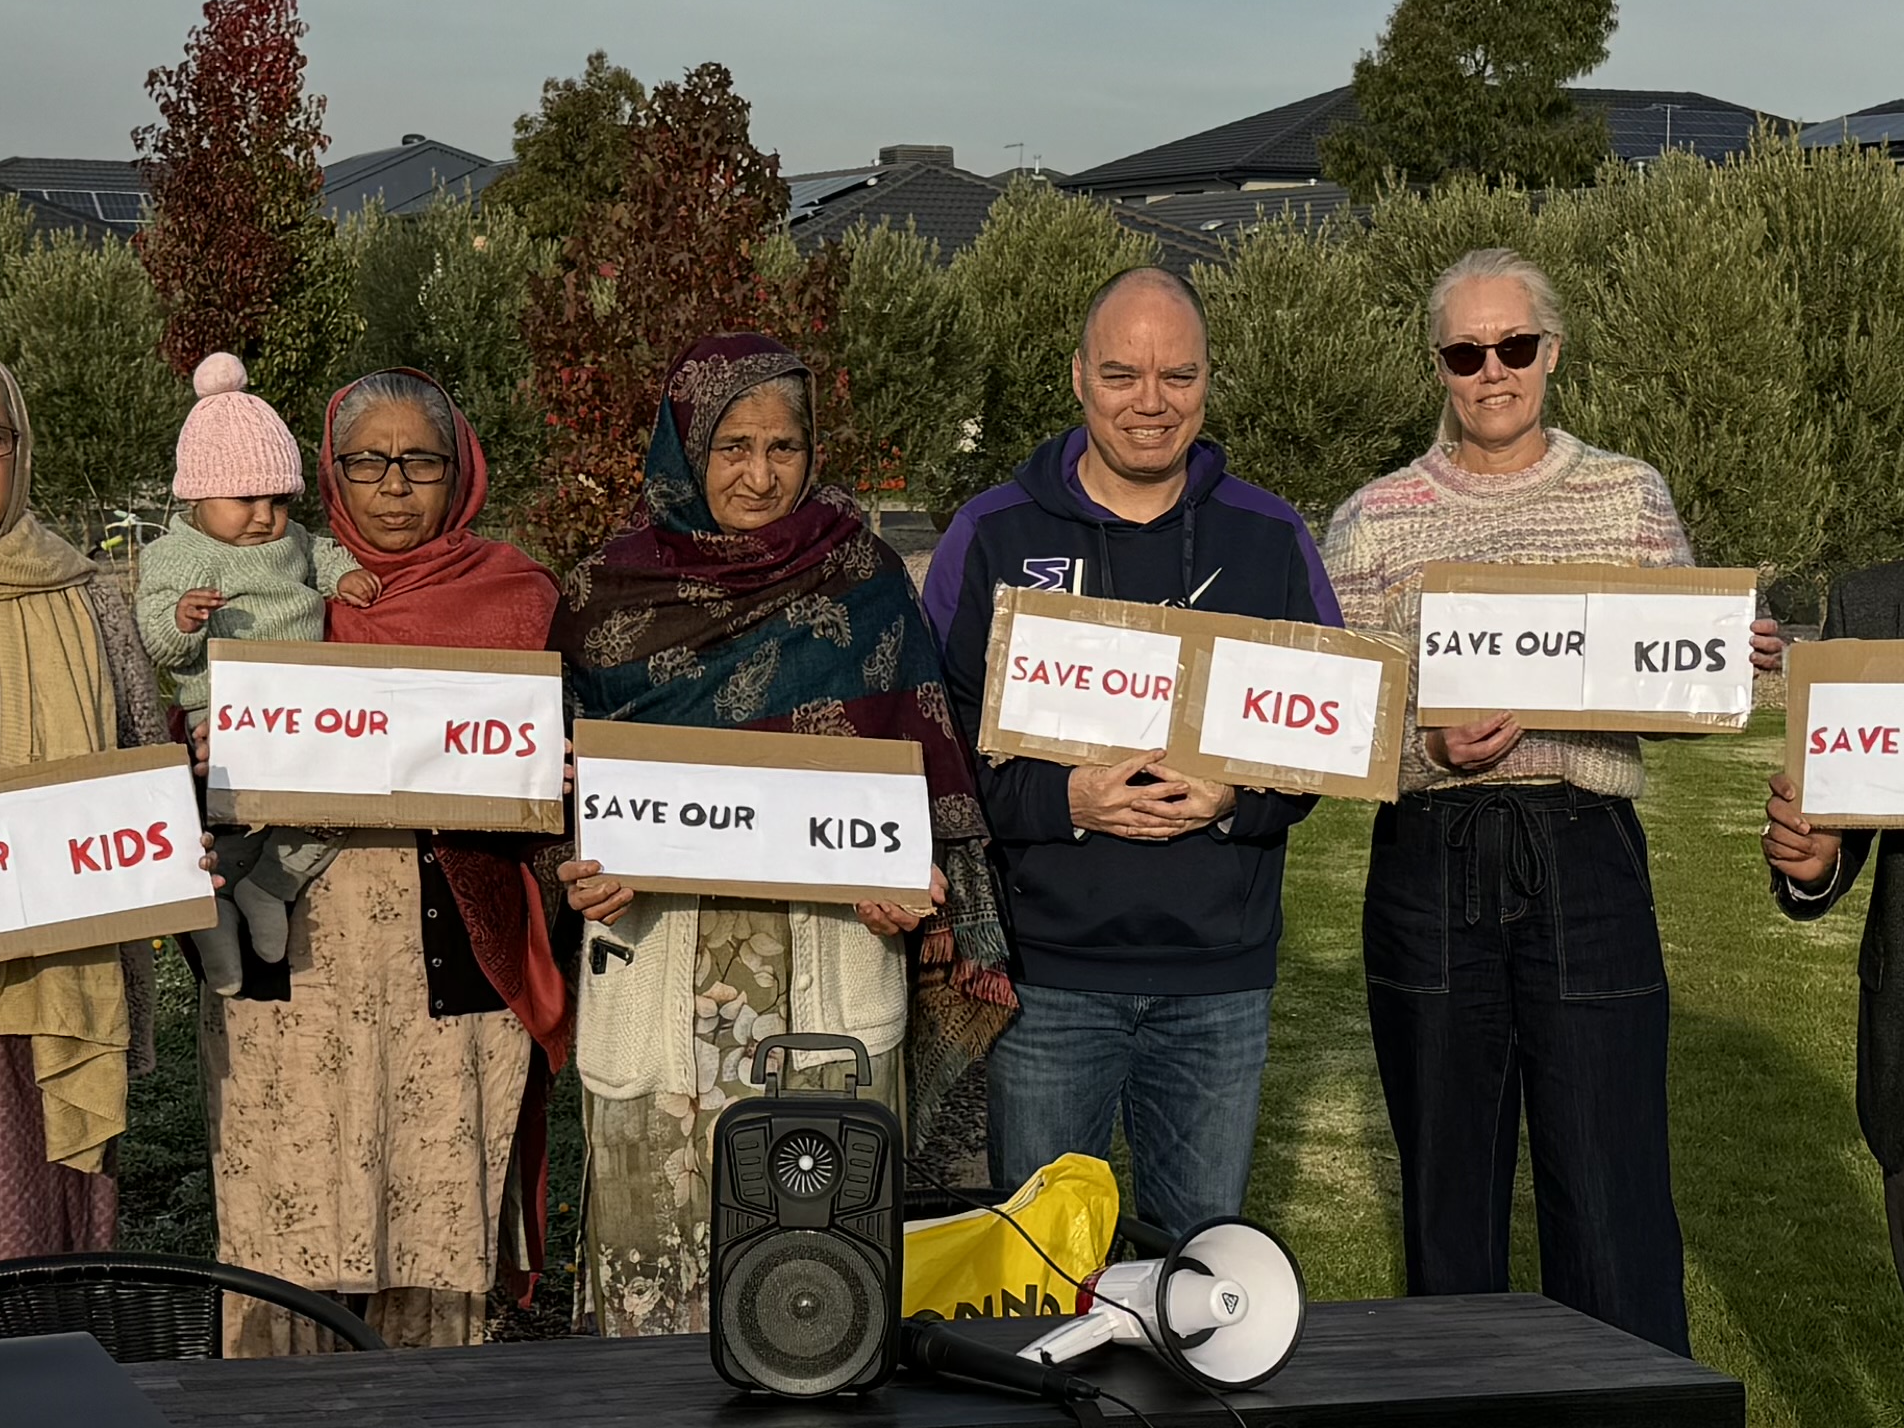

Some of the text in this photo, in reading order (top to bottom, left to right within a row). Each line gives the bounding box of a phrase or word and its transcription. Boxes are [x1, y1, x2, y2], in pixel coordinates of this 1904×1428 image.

[1426, 630, 1727, 674] SAVE OUR KIDS
[1011, 655, 1340, 736] SAVE OUR KIDS
[217, 705, 536, 758] SAVE OUR KIDS
[1809, 726, 1899, 756] SAVE
[69, 821, 174, 875] KIDS
[583, 793, 902, 853] SAVE OUR KIDS
